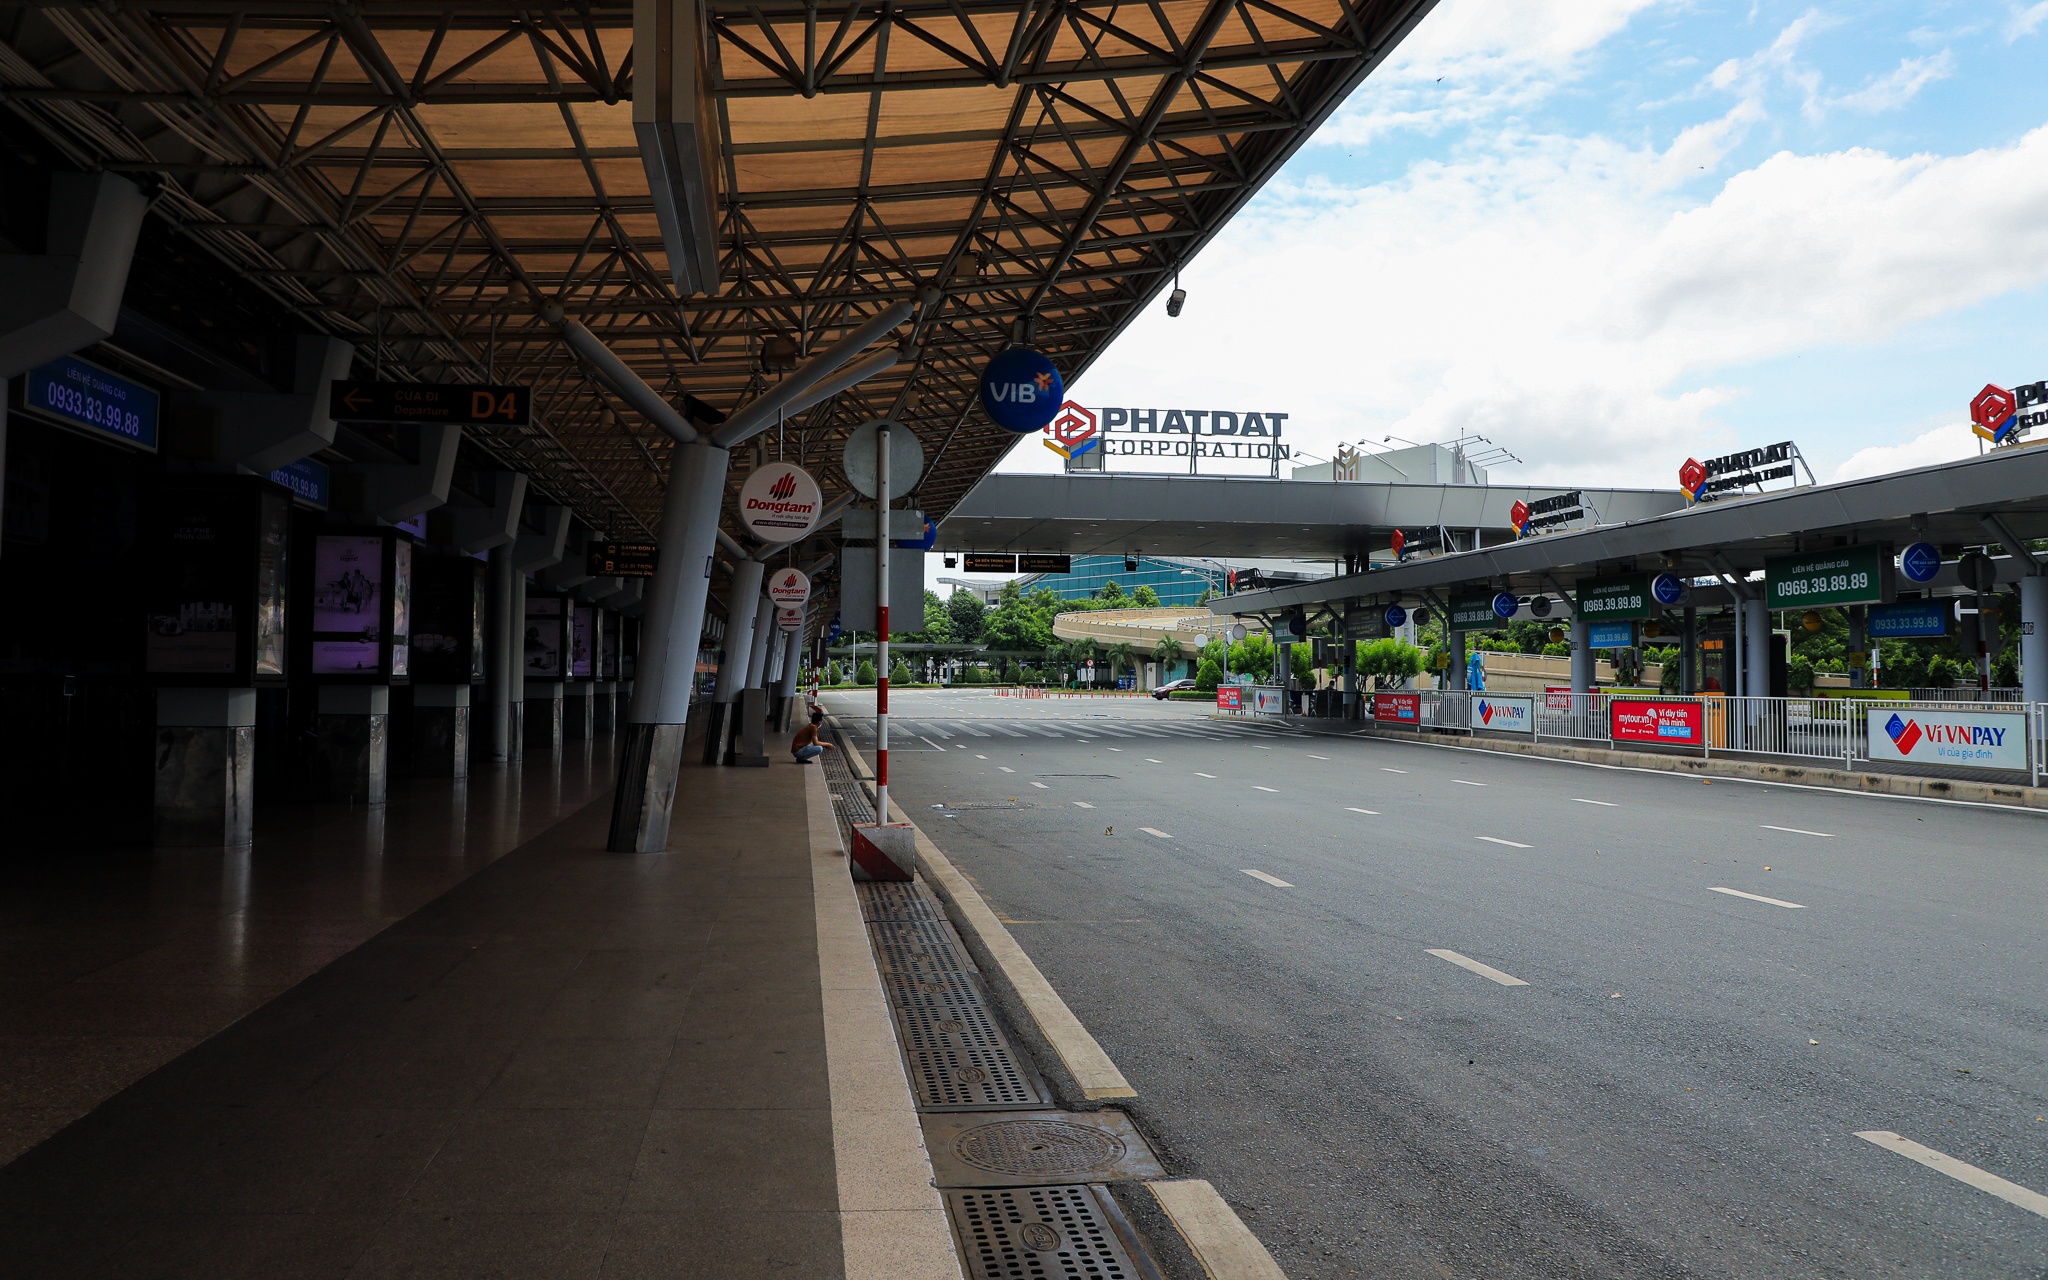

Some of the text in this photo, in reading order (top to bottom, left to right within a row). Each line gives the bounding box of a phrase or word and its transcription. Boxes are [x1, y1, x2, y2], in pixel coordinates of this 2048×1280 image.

[990, 382, 1036, 403] VIB
[48, 381, 139, 437] 0933.33.99.88
[394, 405, 449, 416] Departure
[471, 390, 517, 420] D4
[1103, 408, 1288, 436] PHATDAT
[1104, 439, 1289, 459] CORPORATION
[1704, 441, 1791, 476] PHATDAT
[1708, 466, 1793, 493] CORPORATION
[747, 498, 812, 514] Dongtam
[606, 561, 615, 571] B
[1792, 559, 1849, 574] LIÊN HỆ QUẢNG CÁO
[1777, 572, 1868, 597] 0969.39.89.89
[1584, 595, 1642, 612] 0969.39.89.89
[1454, 610, 1493, 623] 0969.39.89.89
[1875, 617, 1938, 630] 0933.33.99.88
[1502, 706, 1526, 719] VNPAY
[1619, 713, 1650, 725] mytour.vn
[1924, 724, 2006, 747] Ví VNPAY
[1947, 746, 1960, 757] của
[1962, 748, 1973, 760] gia
